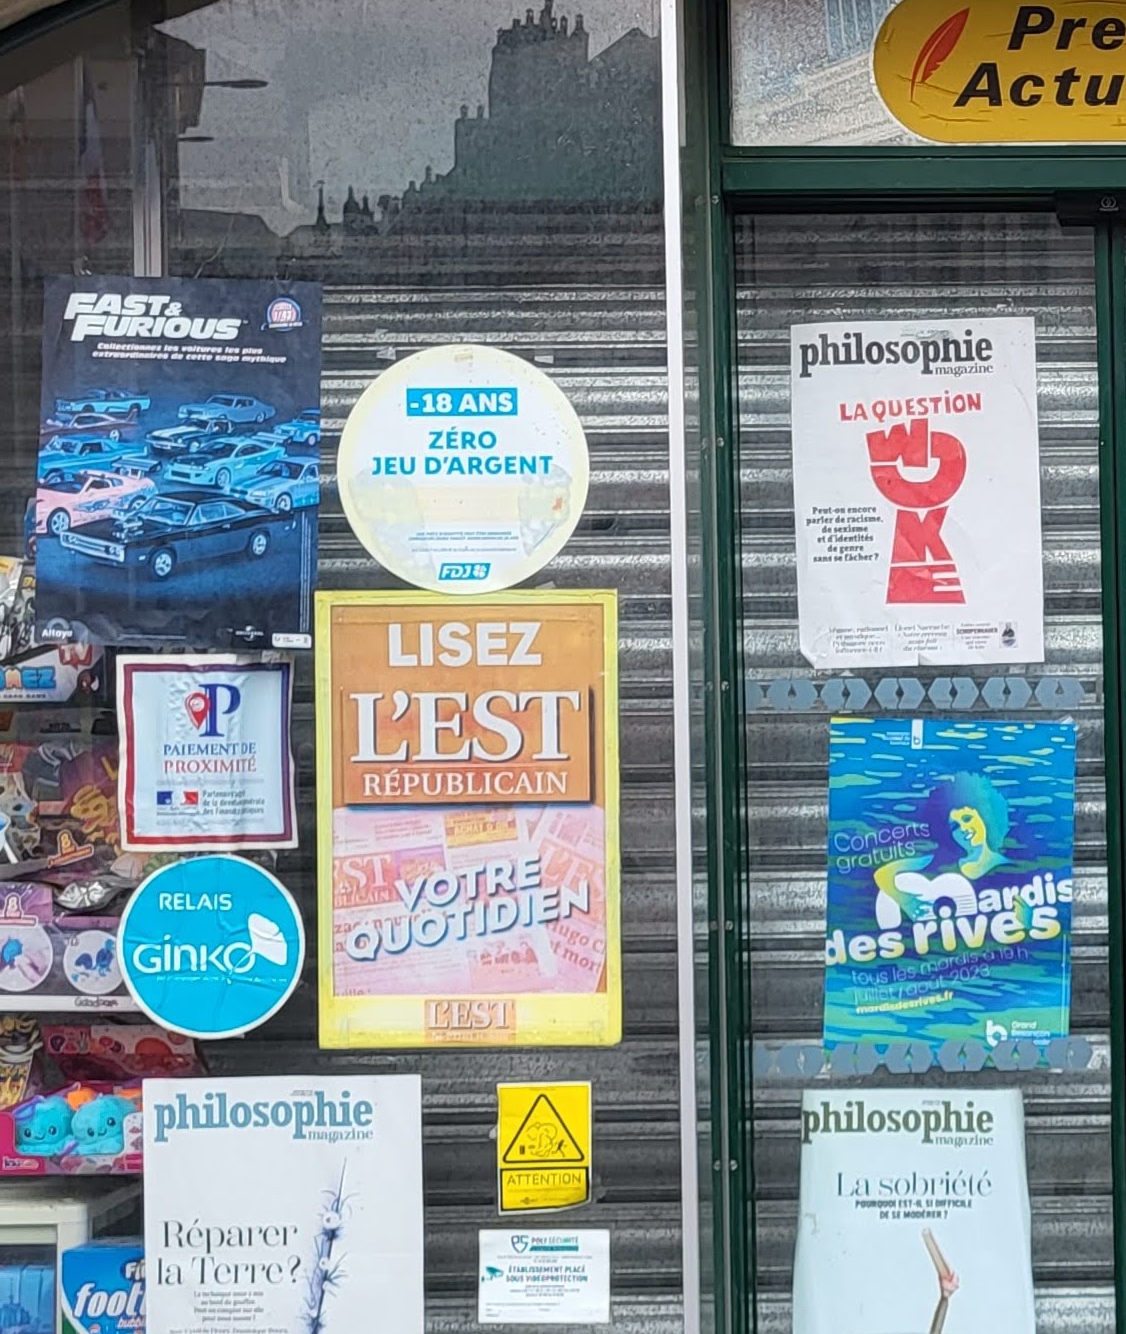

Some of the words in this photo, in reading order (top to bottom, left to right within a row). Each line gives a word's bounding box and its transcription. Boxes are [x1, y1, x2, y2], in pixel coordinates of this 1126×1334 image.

[70, 314, 242, 342] FURIOUS
[458, 392, 513, 413] ANS
[840, 402, 868, 422] LA
[872, 390, 982, 423] QUESTION
[428, 426, 497, 450] ZÉRO
[372, 456, 416, 476] JEU
[424, 455, 553, 475] D'ARGENT
[812, 506, 846, 515] Peut-on
[847, 505, 877, 514] encore
[387, 621, 542, 667] LISEZ
[349, 690, 581, 764] L'EST
[163, 742, 239, 756] PAIEMENT
[241, 742, 257, 755] DE
[164, 755, 257, 774] PROXIMITÉ
[363, 769, 568, 797] RÉPUBLICAIN
[833, 821, 931, 853] Concerts
[836, 840, 917, 875] gratuits
[395, 851, 542, 913] VOTRE
[158, 892, 233, 911] RELAIS
[346, 878, 591, 962] QUOTIDIEN
[825, 929, 905, 966] des
[913, 906, 1062, 955] rives
[153, 1089, 374, 1142] philosophie
[802, 1099, 994, 1146] philosophie
[307, 1128, 374, 1143] magazine
[506, 1171, 582, 1187] ATTENTION
[837, 1173, 870, 1197] La
[878, 1170, 993, 1198] sobriété
[162, 1218, 298, 1255] Réparer
[157, 1257, 183, 1286] la
